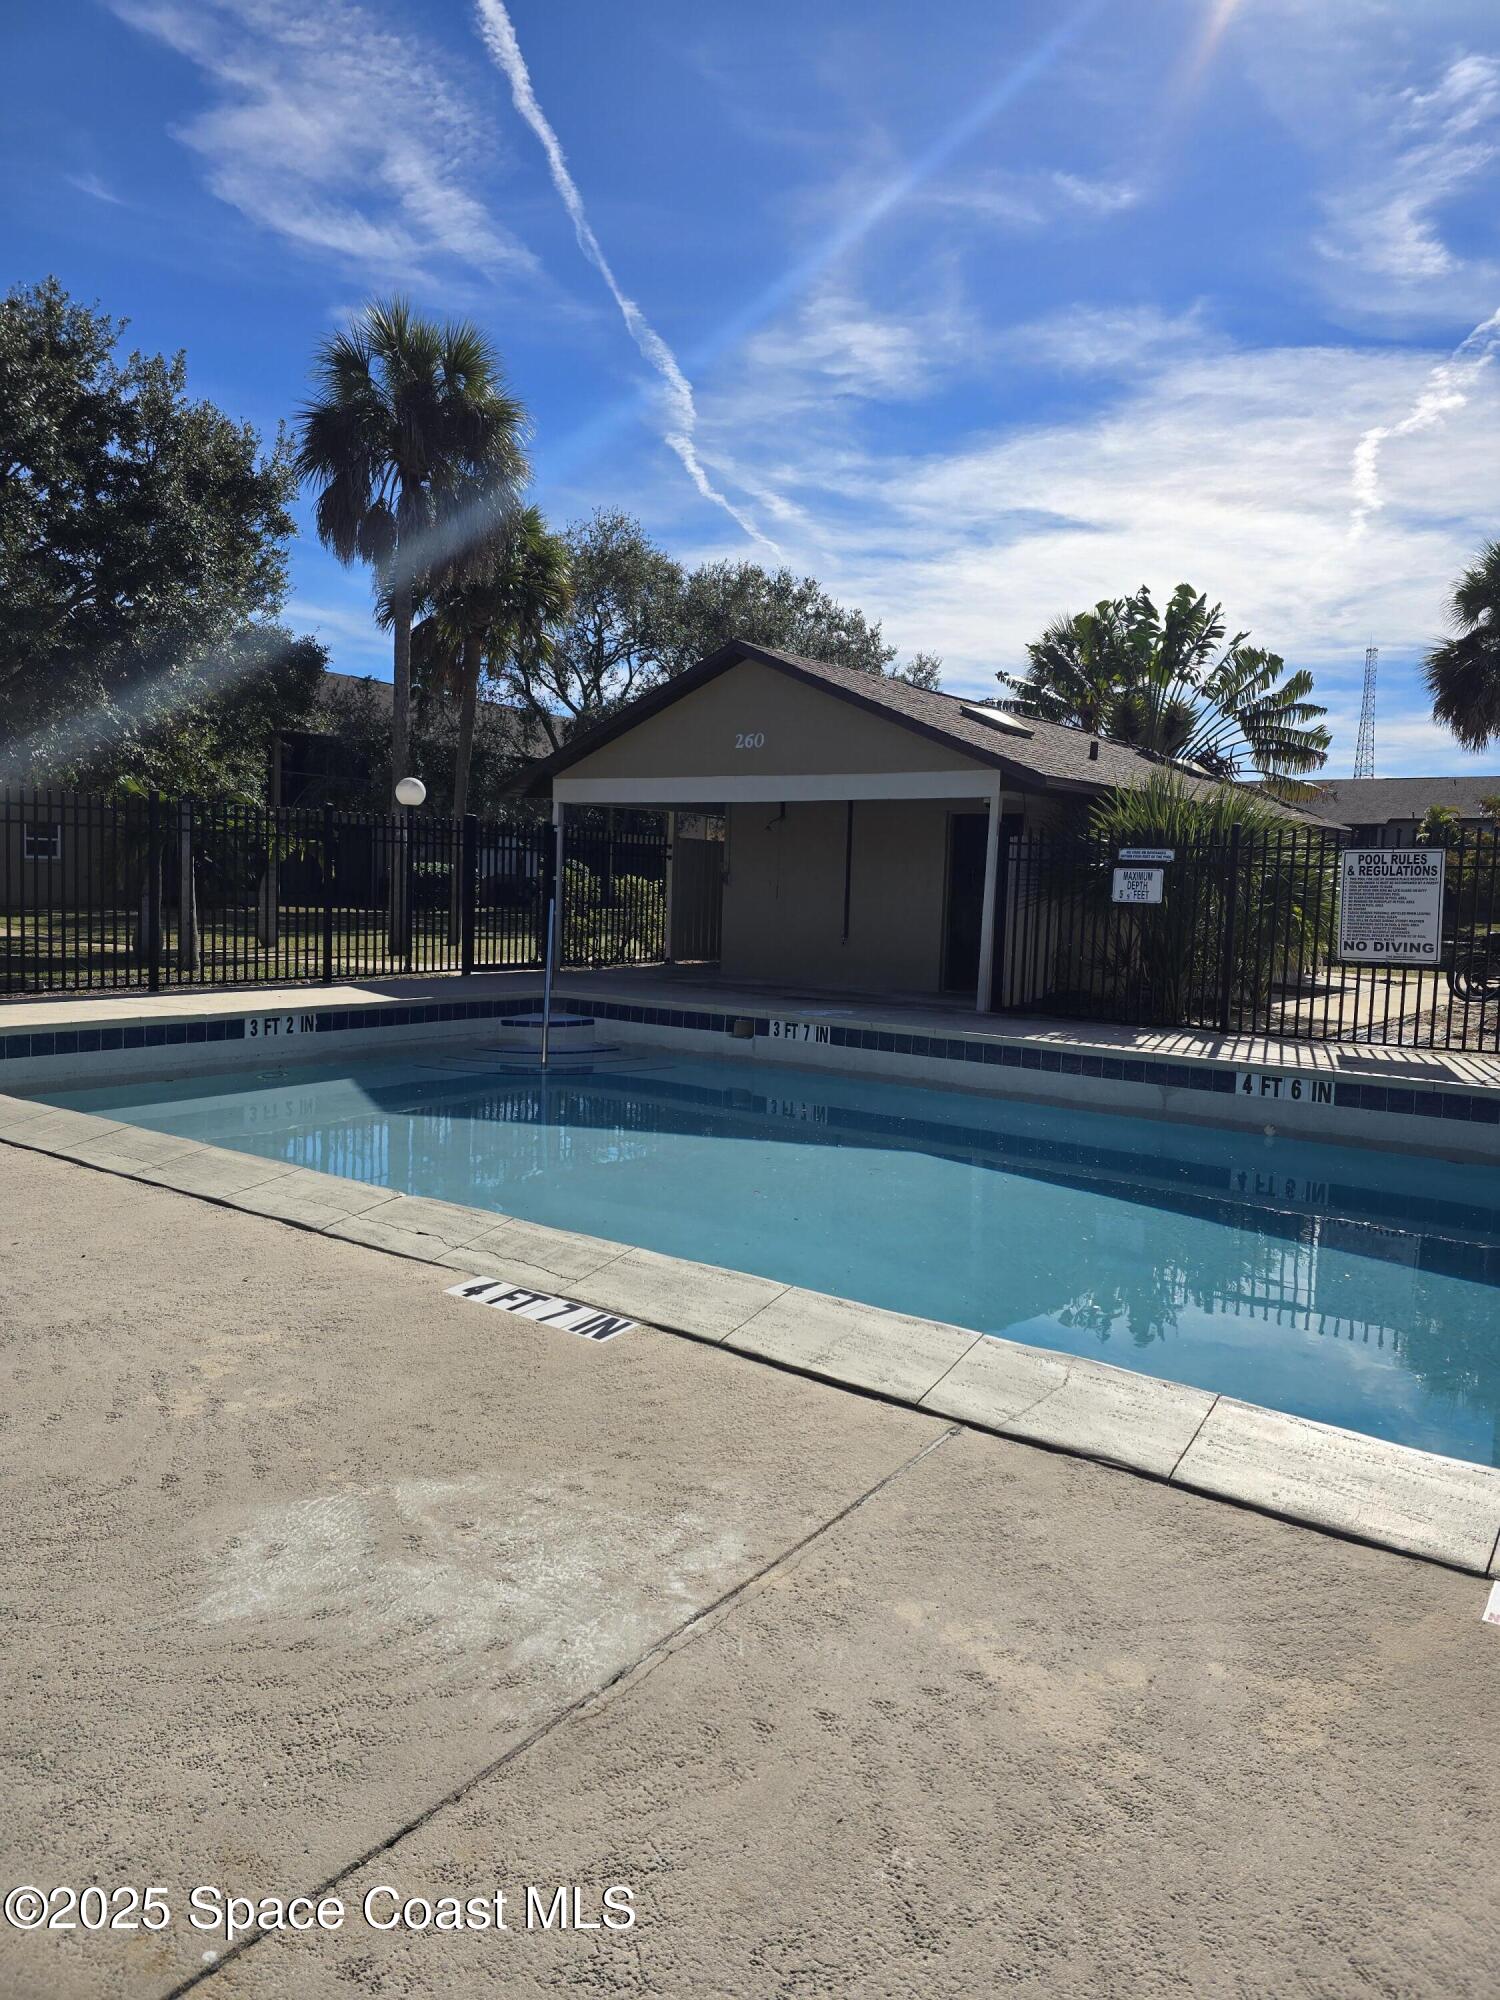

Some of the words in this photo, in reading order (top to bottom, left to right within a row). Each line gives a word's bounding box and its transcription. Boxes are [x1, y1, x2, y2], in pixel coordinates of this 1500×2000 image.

[735, 732, 765, 749] 260
[1358, 854, 1388, 865] POOL
[1391, 854, 1428, 865] RULES
[1123, 871, 1153, 881] MAXIMUM
[1347, 865, 1355, 876] &
[1358, 865, 1438, 877] REGULATIONS
[1127, 881, 1148, 890] DEPTH
[1133, 890, 1150, 900] FEET
[1343, 941, 1367, 951] NO
[1373, 942, 1435, 953] DIVING
[250, 1019, 258, 1037] 3
[264, 1017, 280, 1036] FT
[286, 1016, 294, 1034] 2
[300, 1015, 314, 1033] IN
[773, 1021, 780, 1037] 3
[784, 1022, 798, 1039] FT
[803, 1024, 810, 1041] 7
[815, 1025, 829, 1043] IN
[1242, 1073, 1253, 1094] 4
[1261, 1075, 1283, 1098] FT
[1291, 1079, 1302, 1100] 6
[1311, 1081, 1332, 1103] IN
[461, 1281, 503, 1298] 4
[485, 1288, 552, 1311] FT
[535, 1302, 583, 1322] 7
[567, 1313, 634, 1341] IN
